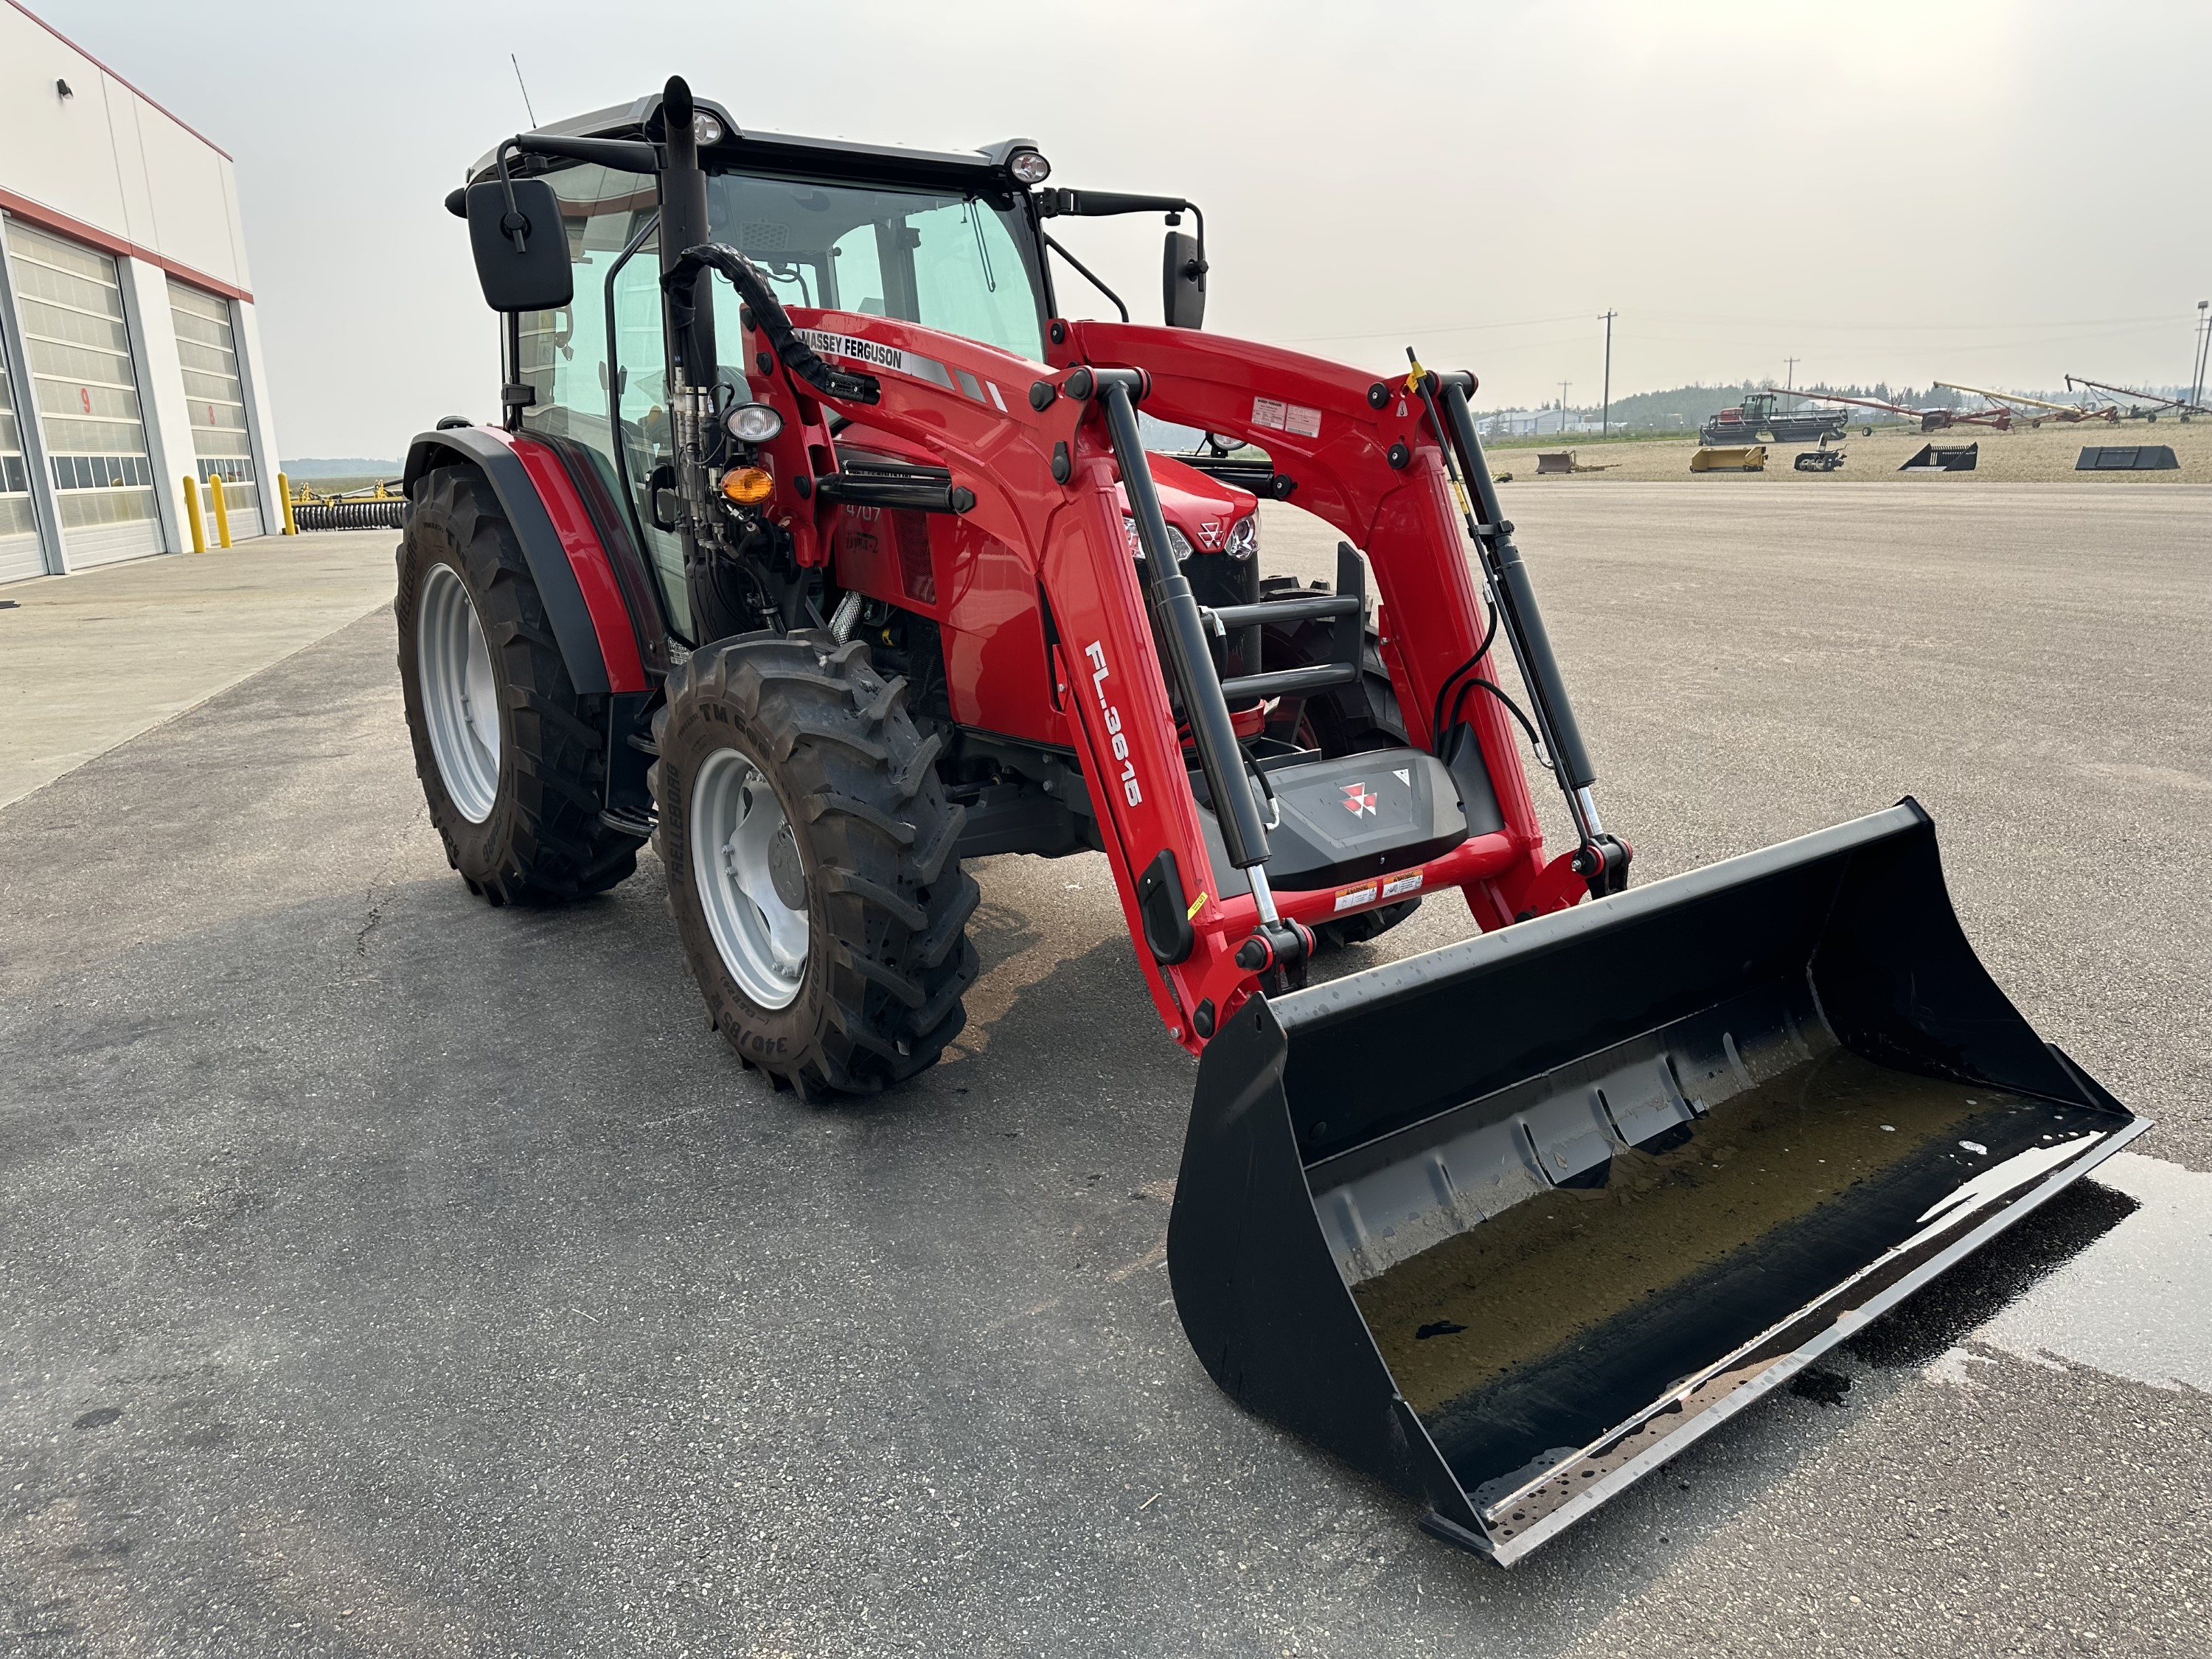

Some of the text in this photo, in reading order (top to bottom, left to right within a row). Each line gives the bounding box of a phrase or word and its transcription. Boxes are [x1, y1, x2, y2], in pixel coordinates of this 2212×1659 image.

[801, 330, 902, 369] MASSEY FERGUSON
[81, 388, 90, 413] 9
[209, 406, 215, 425] 8
[699, 703, 729, 725] TM
[734, 714, 770, 762] 600
[666, 761, 684, 886] TRELLEBORG
[721, 1011, 788, 1055] 340/85
